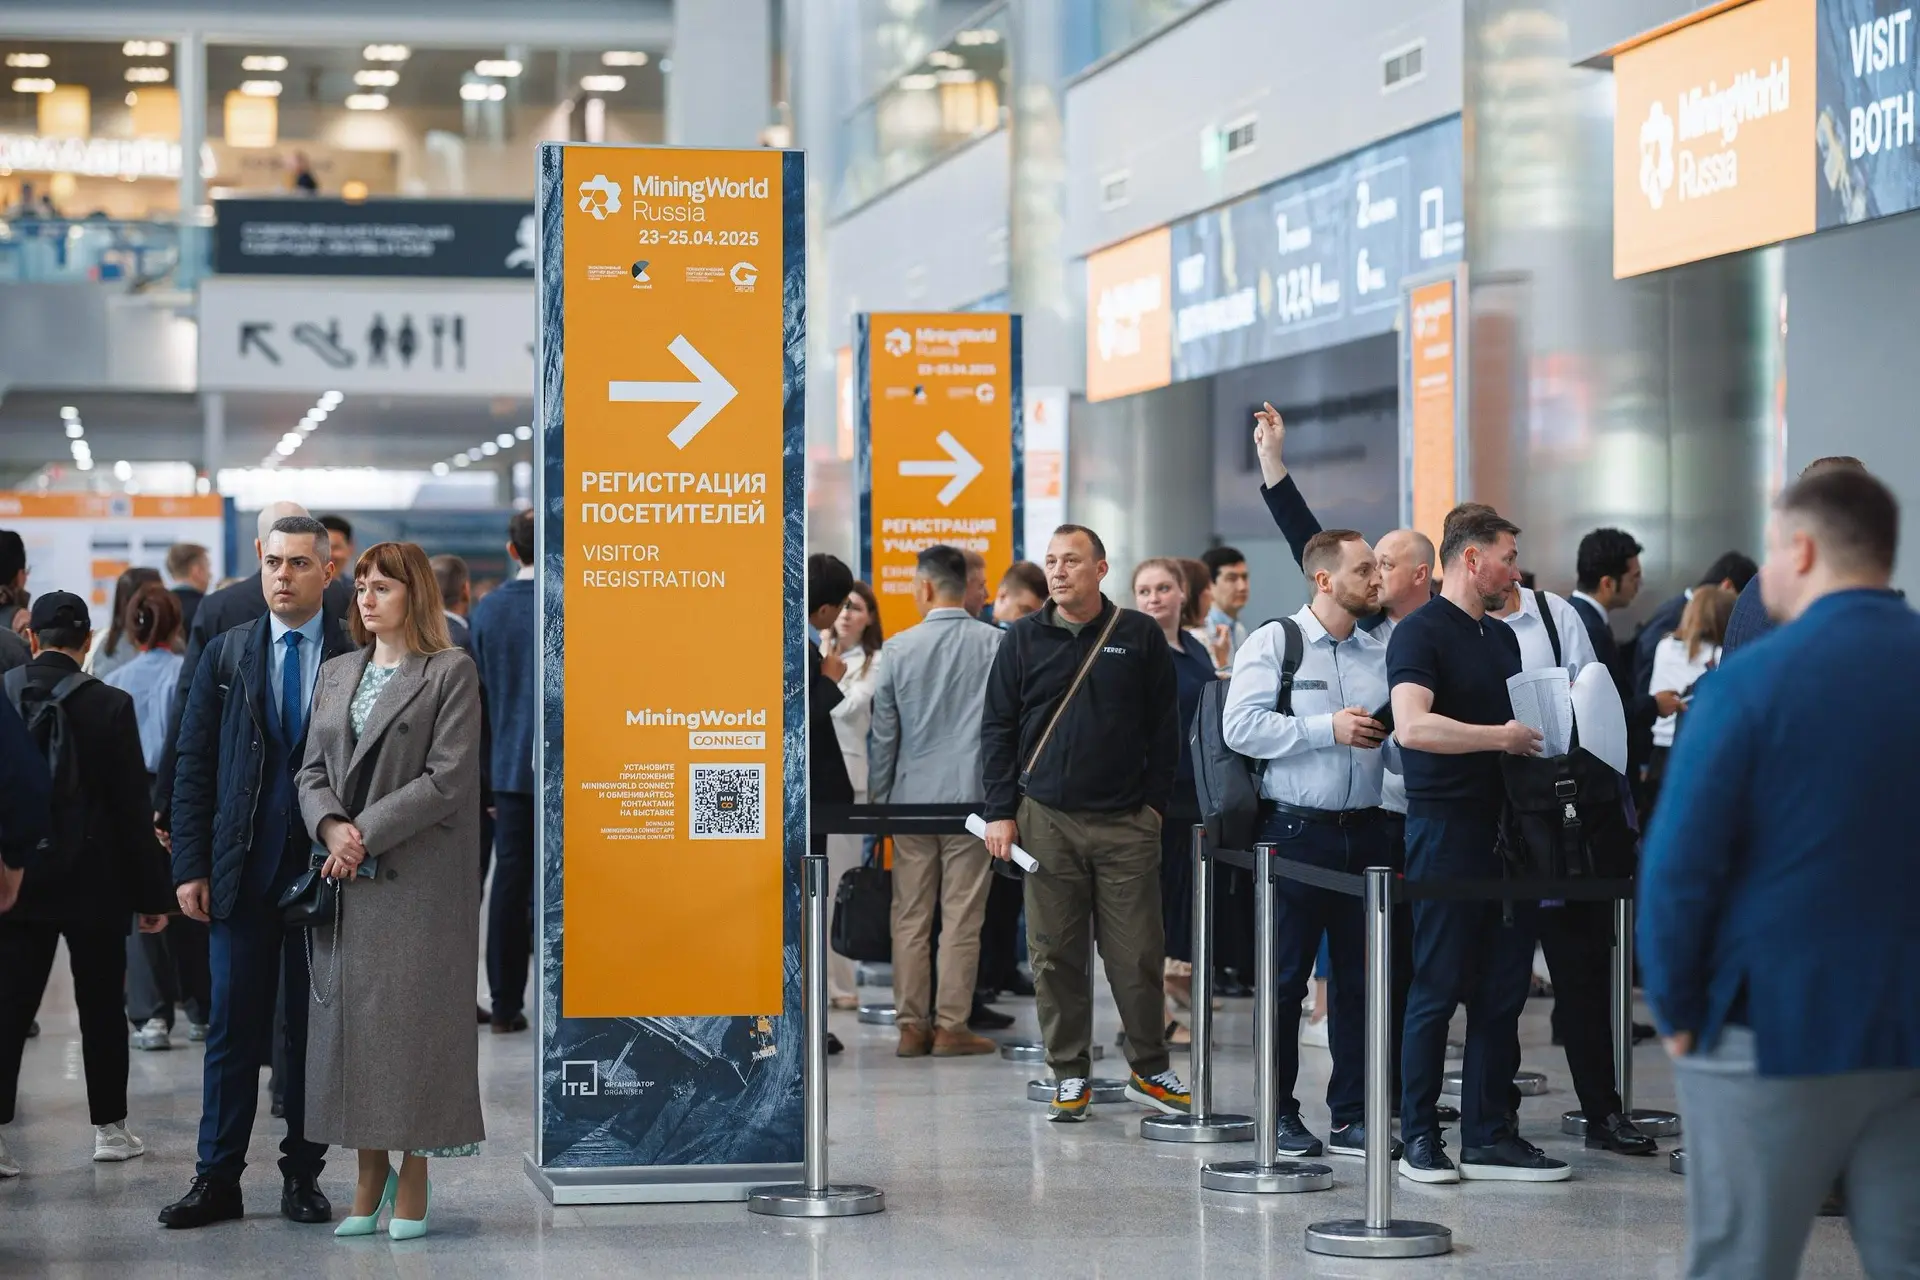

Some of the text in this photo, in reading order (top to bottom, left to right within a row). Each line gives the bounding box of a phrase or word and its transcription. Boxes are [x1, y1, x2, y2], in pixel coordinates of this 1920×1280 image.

[1850, 8, 1912, 78] VISIT
[1678, 56, 1790, 145] MiningWorld
[1850, 90, 1914, 160] BOTH
[1678, 141, 1738, 201] Russia
[633, 175, 769, 203] MiningWorld
[633, 201, 706, 222] Russia
[582, 471, 766, 497] РЕГИСТРАЦИЯ
[582, 499, 765, 524] ПОСЕТИТЕЛЕЙ
[882, 518, 997, 534] РЕГИСТРАЦИЯ
[583, 545, 660, 561] VISITOR
[583, 570, 725, 588] REGISTRATION
[1103, 646, 1127, 655] TERREX
[626, 708, 767, 729] MiningWorld
[693, 735, 762, 746] CONNECT
[624, 763, 675, 771] УСТАНОВИТЕ
[581, 782, 675, 790] MININGWORLD CONNECT
[598, 790, 675, 799] И ОБМЕНИВАЙТЕСЬ
[620, 809, 632, 817] НА
[562, 1082, 590, 1096] ITE
[604, 1088, 644, 1096] ORGANISER
